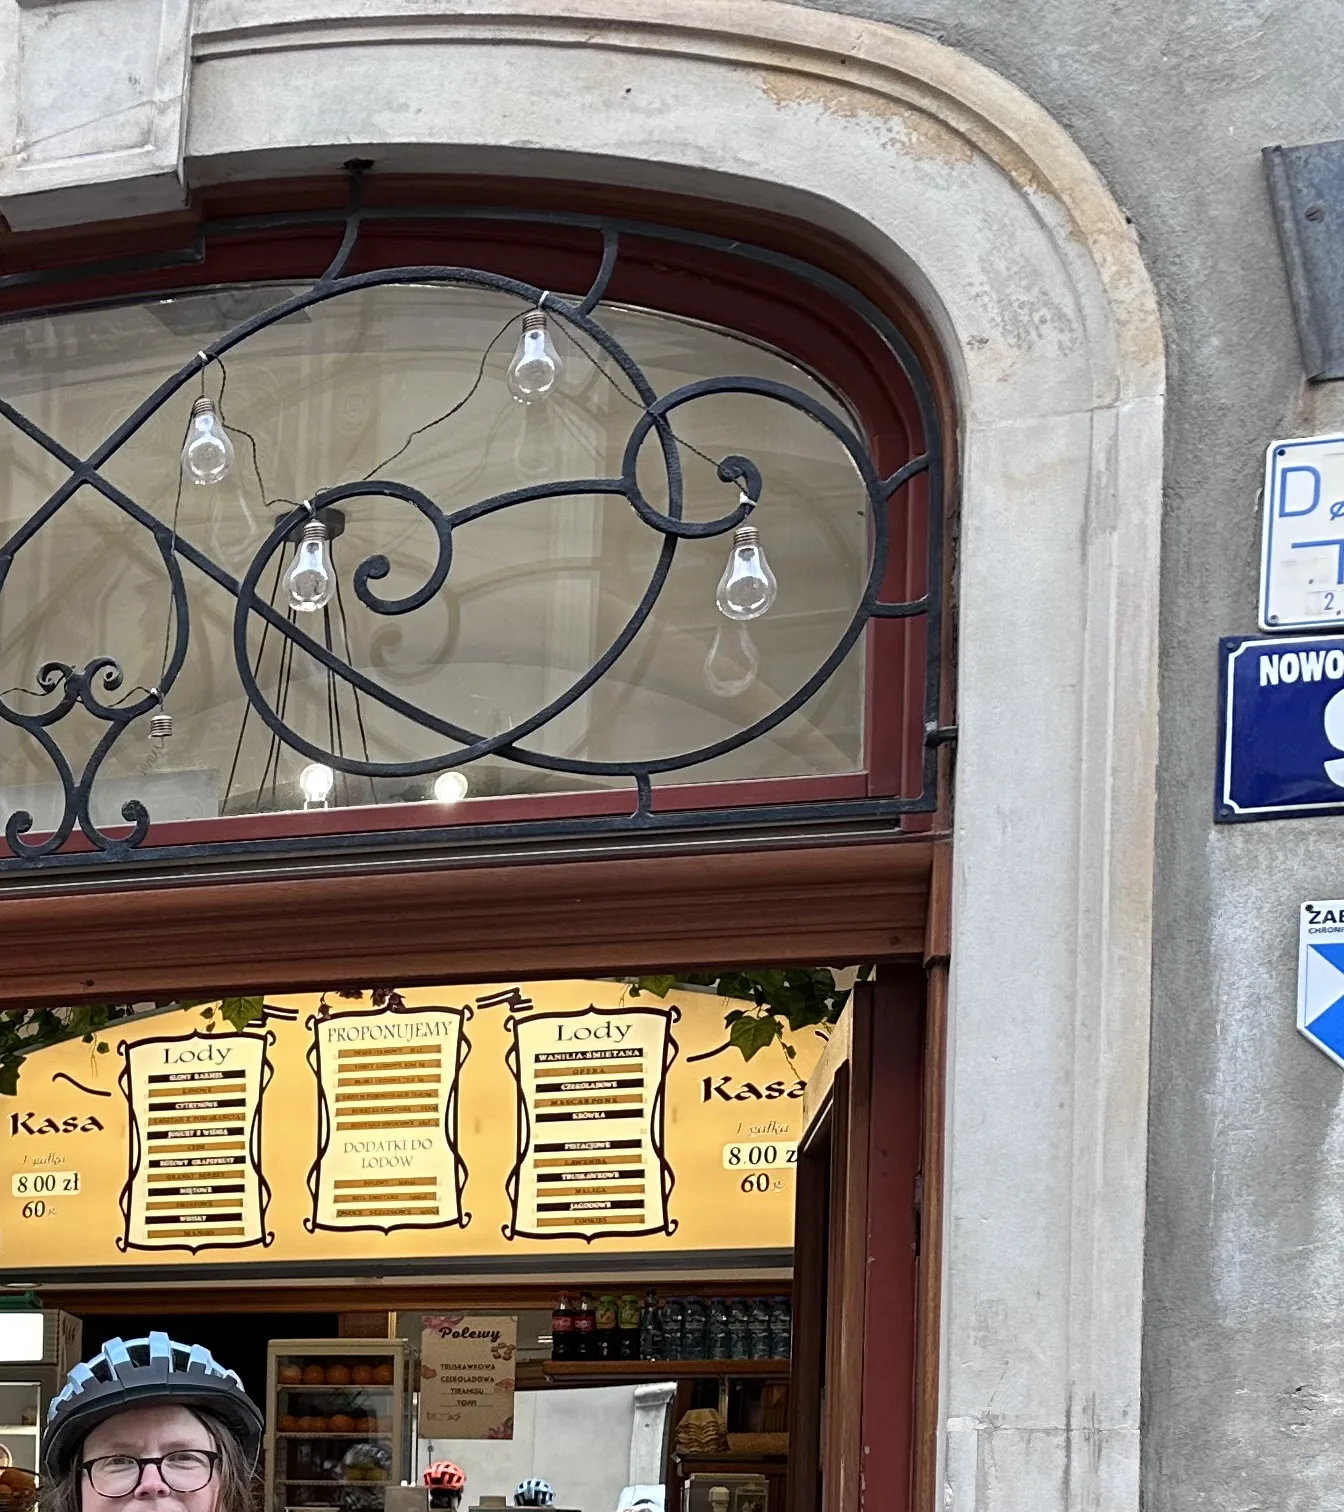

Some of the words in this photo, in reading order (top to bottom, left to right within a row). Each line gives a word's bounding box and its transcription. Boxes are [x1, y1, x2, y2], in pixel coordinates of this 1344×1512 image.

[1278, 465, 1322, 518] D
[1259, 650, 1344, 687] NOWO
[328, 1021, 452, 1042] PROPONUJEMY
[556, 1020, 633, 1043] Lody
[163, 1044, 233, 1065] Lody
[702, 1076, 808, 1103] Kasa
[10, 1112, 104, 1136] Kasa
[343, 1140, 406, 1153] DODATKI
[412, 1138, 433, 1150] DO
[361, 1152, 413, 1169] LODÓW
[63, 1172, 79, 1192] zł
[740, 1172, 770, 1193] 60
[22, 1200, 46, 1219] 60
[438, 1326, 501, 1342] Polewy
